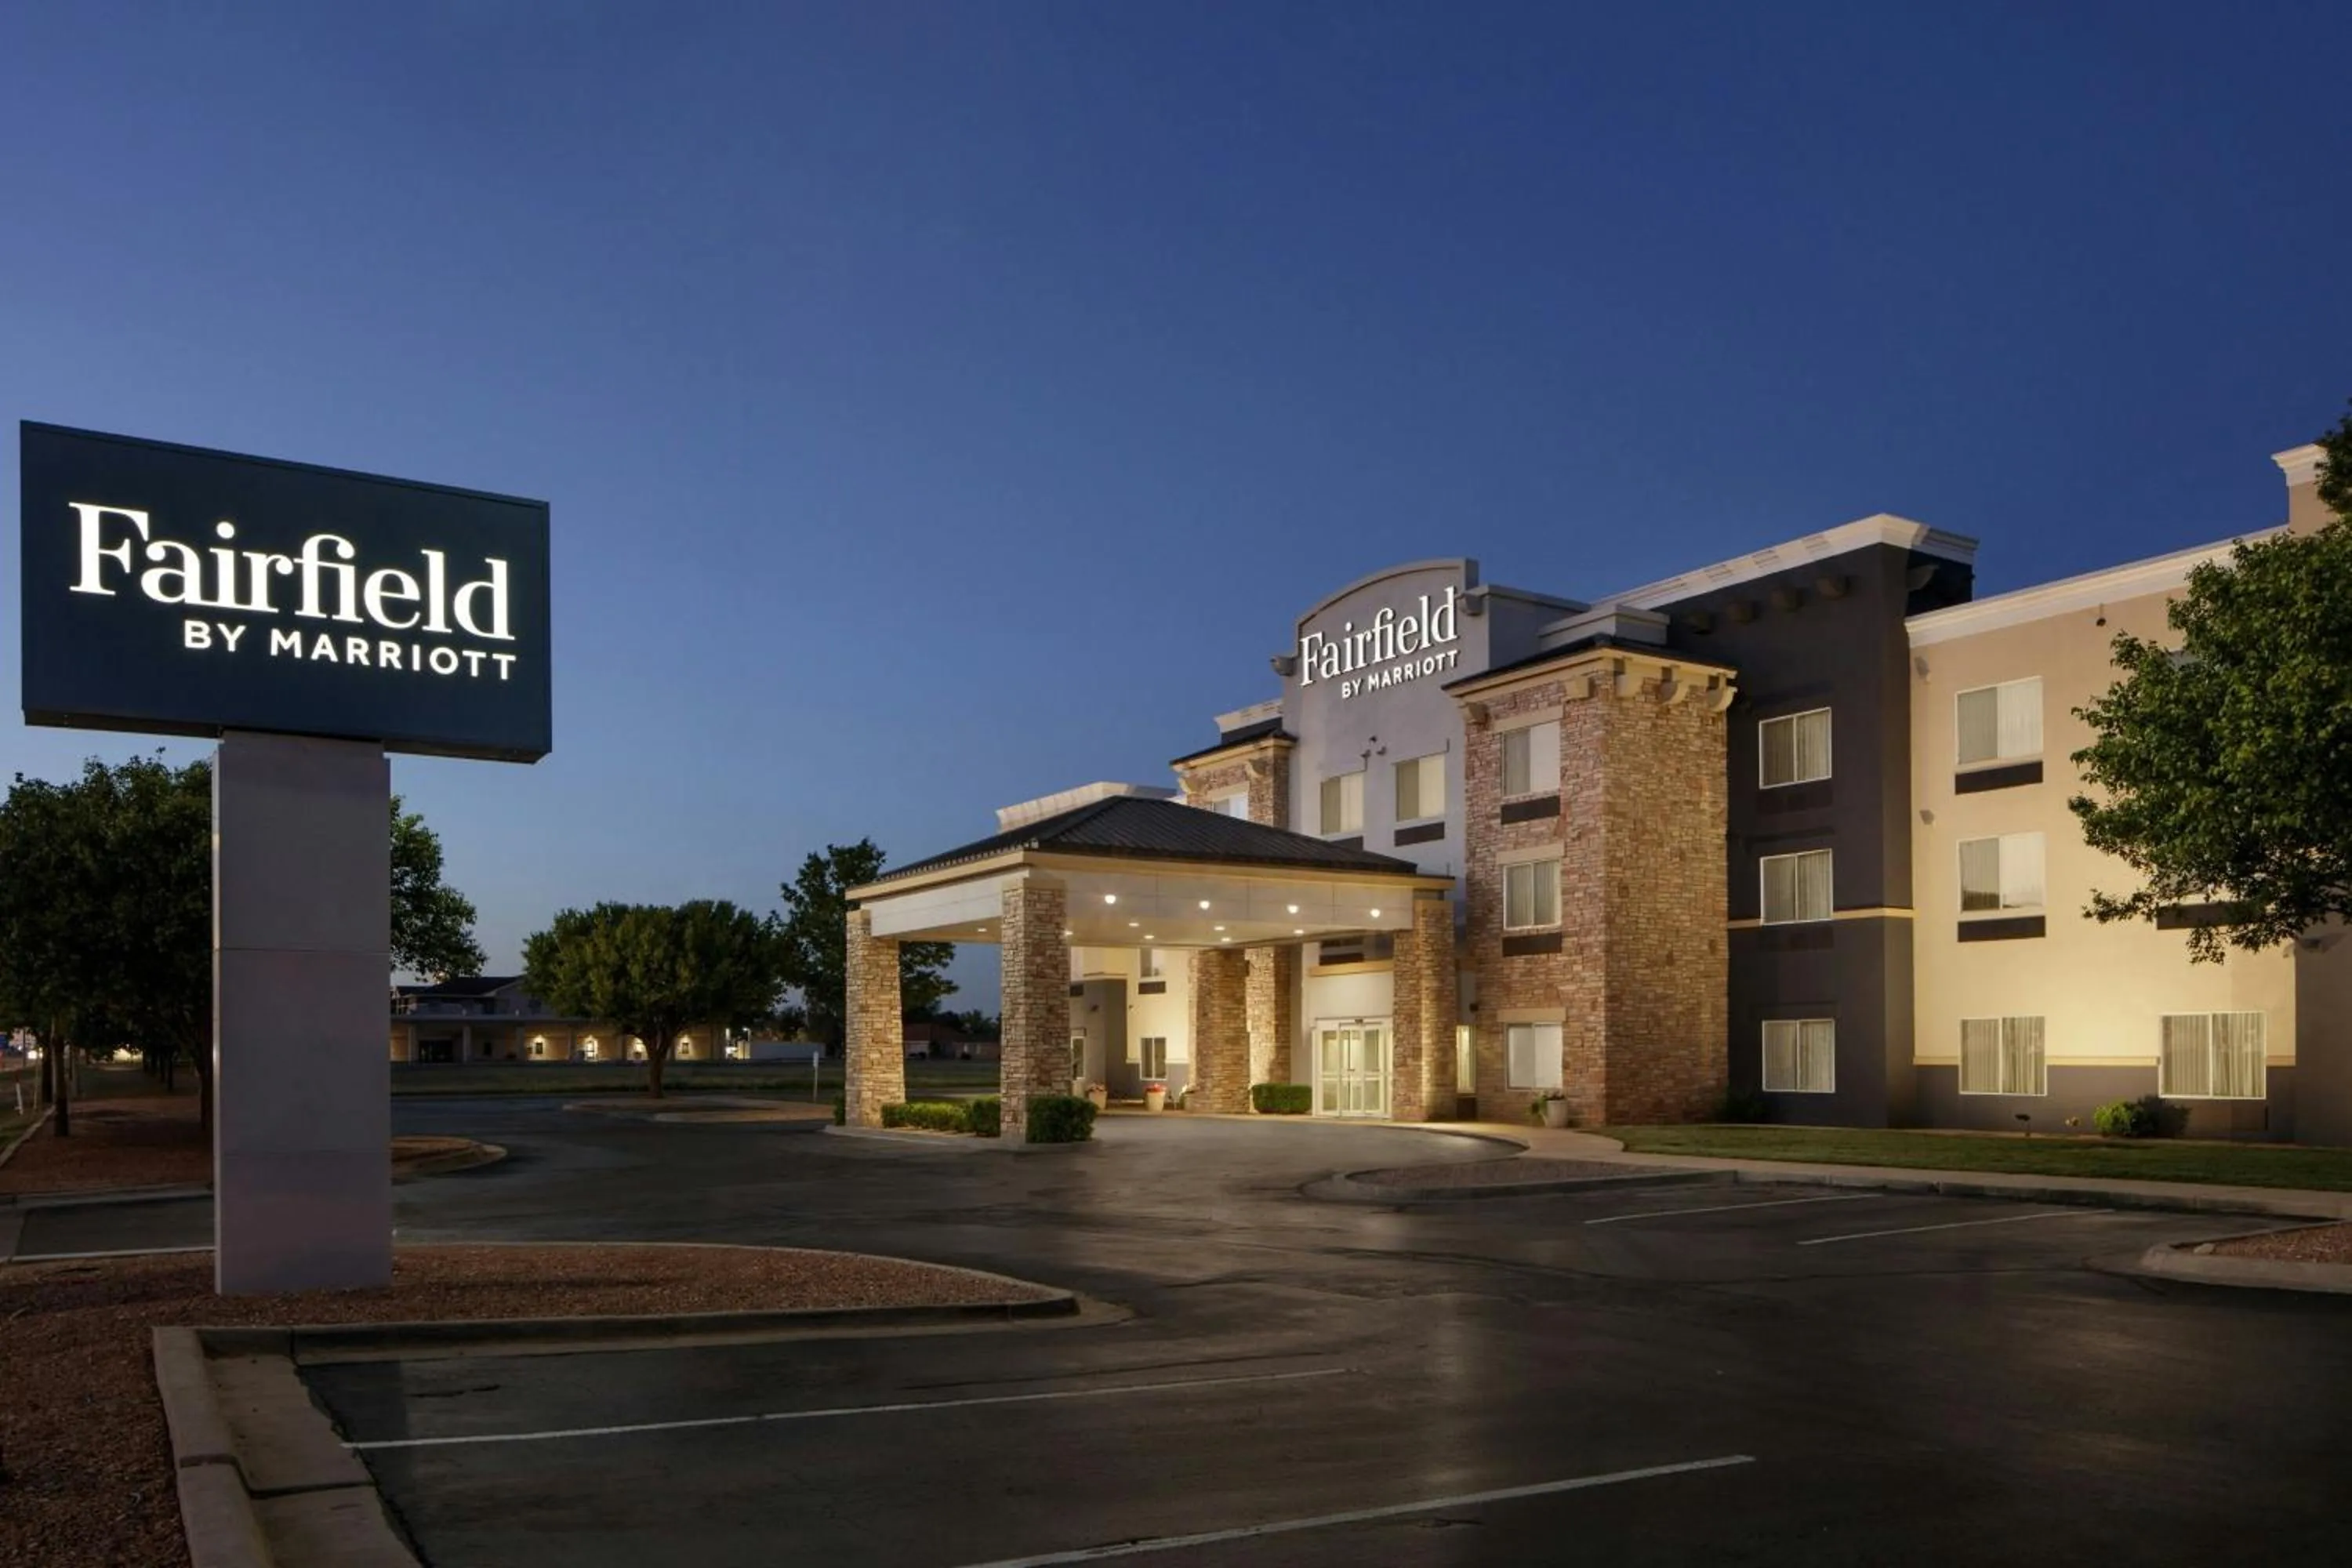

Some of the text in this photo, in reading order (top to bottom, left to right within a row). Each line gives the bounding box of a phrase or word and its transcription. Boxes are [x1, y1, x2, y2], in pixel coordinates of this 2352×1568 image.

[68, 501, 515, 641] Fairfield
[183, 619, 517, 681] BY MARRIOTT
[1300, 585, 1459, 687] Fairfield
[1341, 648, 1459, 699] BY MARRIOTT
